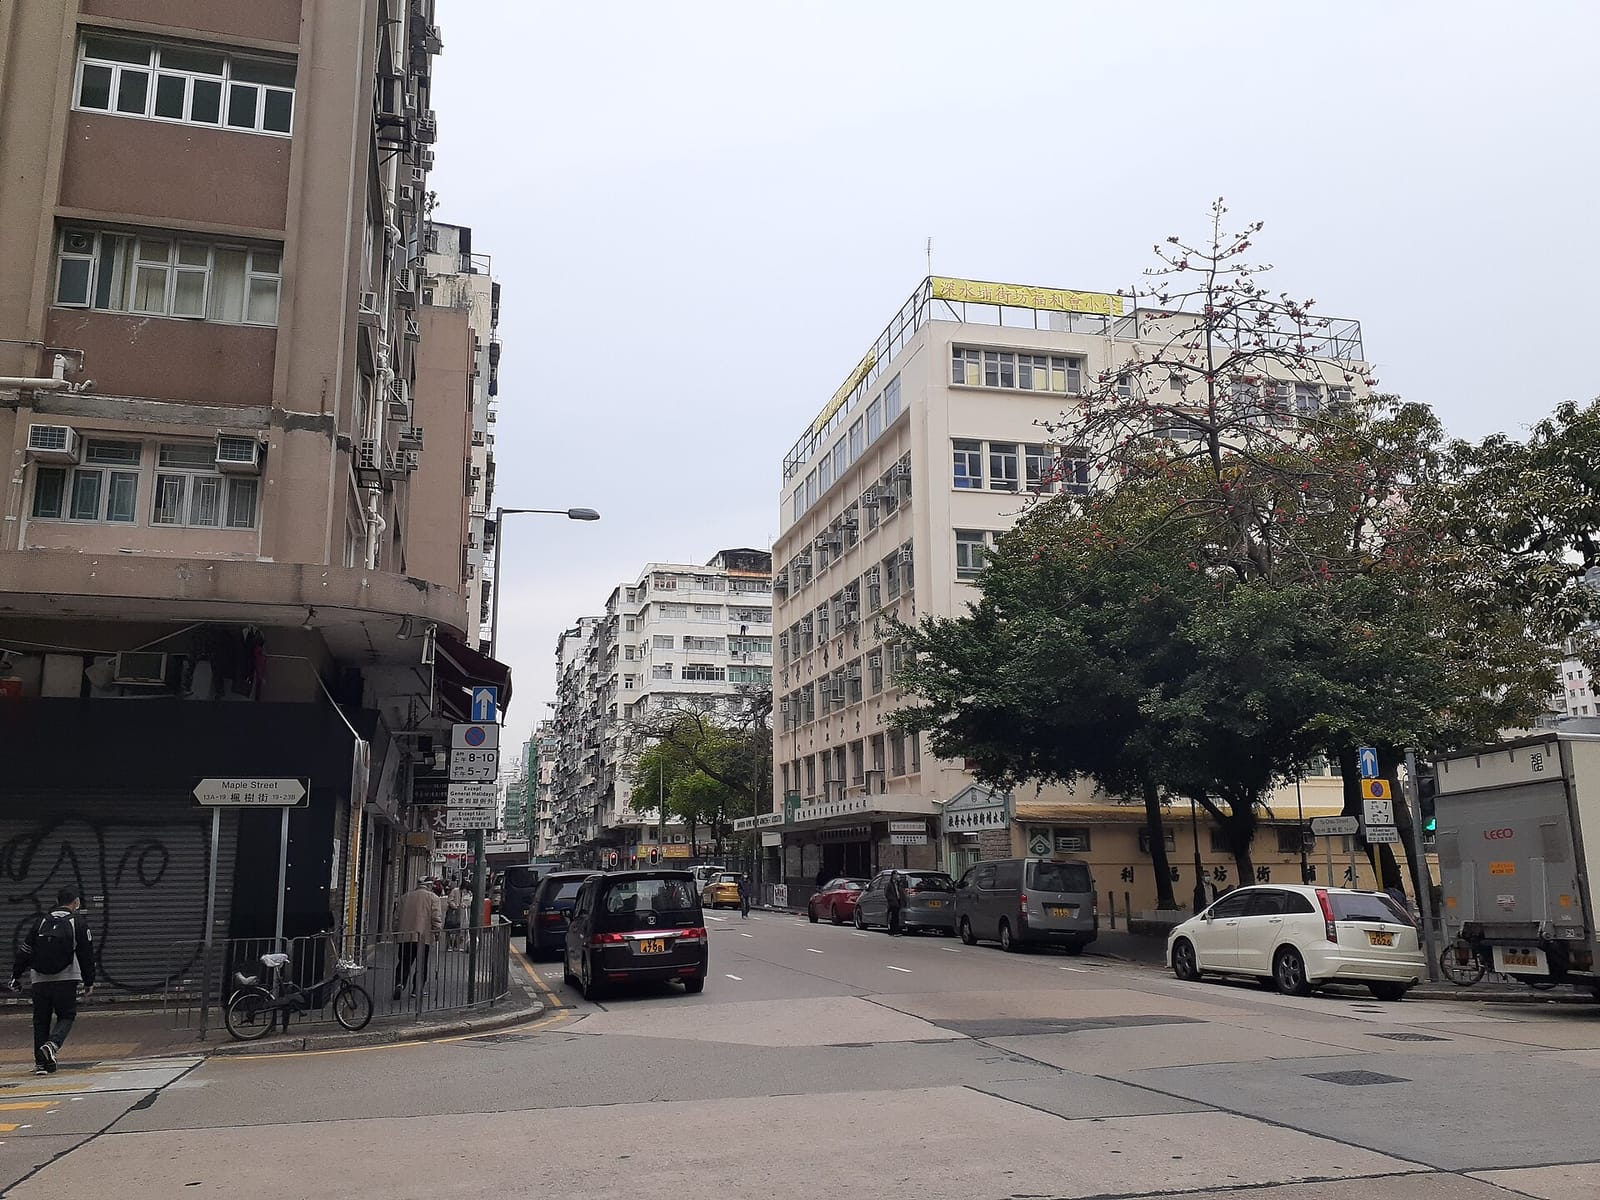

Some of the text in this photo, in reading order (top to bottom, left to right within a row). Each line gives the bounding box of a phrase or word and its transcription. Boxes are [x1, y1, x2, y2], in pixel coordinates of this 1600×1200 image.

[468, 753, 495, 762] 8-10
[221, 781, 278, 790] Maple Street
[1383, 801, 1388, 810] 7
[1384, 814, 1389, 823] 7
